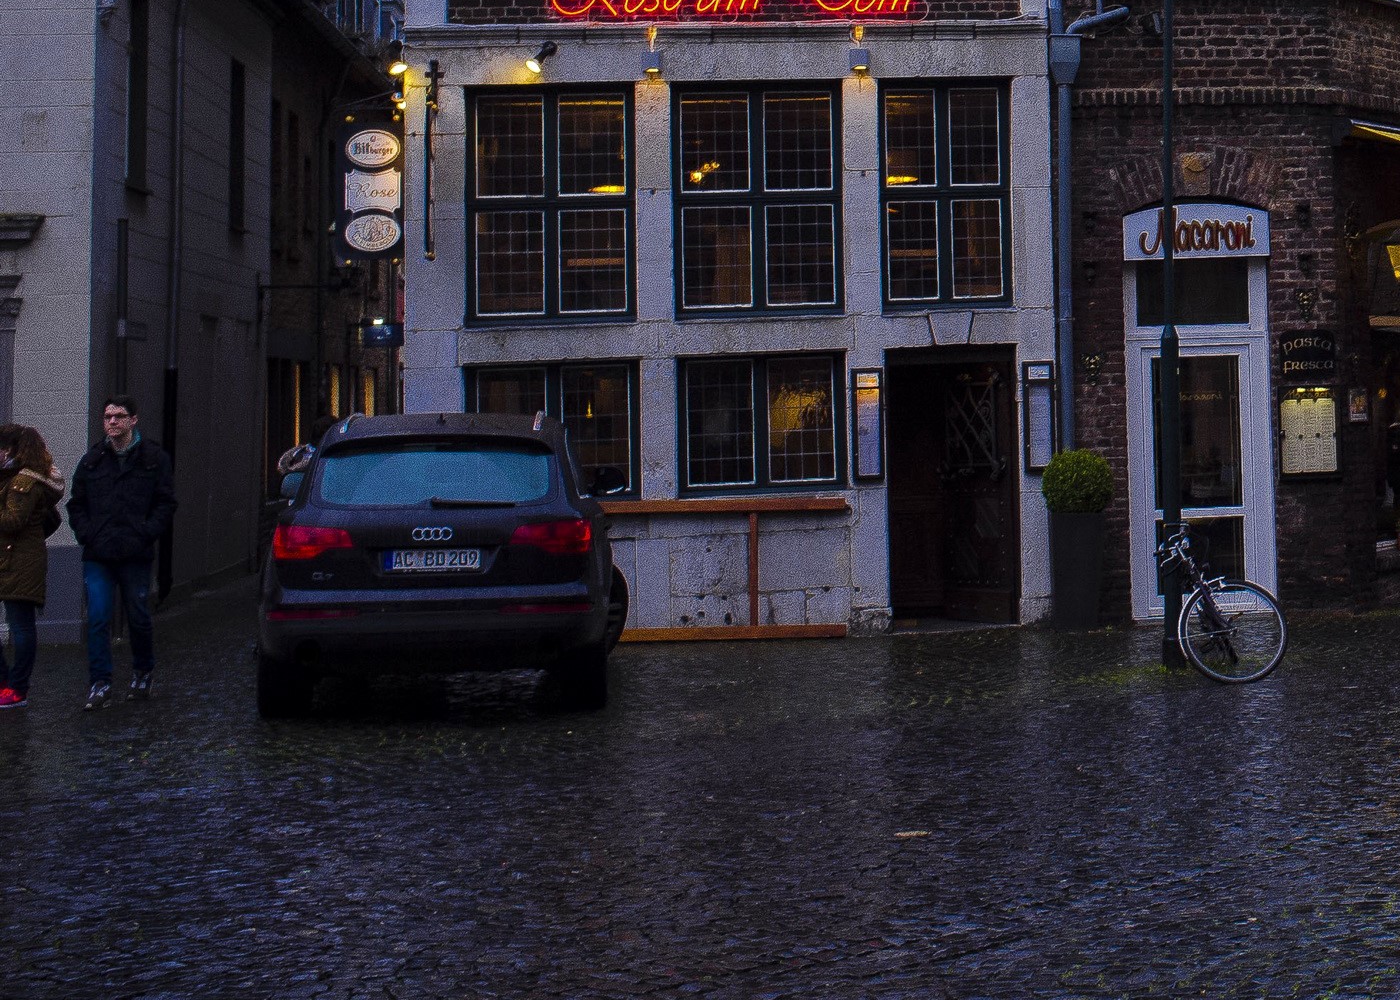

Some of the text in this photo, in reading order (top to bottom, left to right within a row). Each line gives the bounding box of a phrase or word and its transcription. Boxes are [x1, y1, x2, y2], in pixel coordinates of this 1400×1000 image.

[352, 142, 394, 157] Bitburger
[348, 182, 398, 199] Rose
[1139, 205, 1257, 256] Macaroni
[1283, 334, 1332, 355] pasta
[1283, 359, 1334, 374] fresca
[394, 551, 479, 567] AC BD 209
